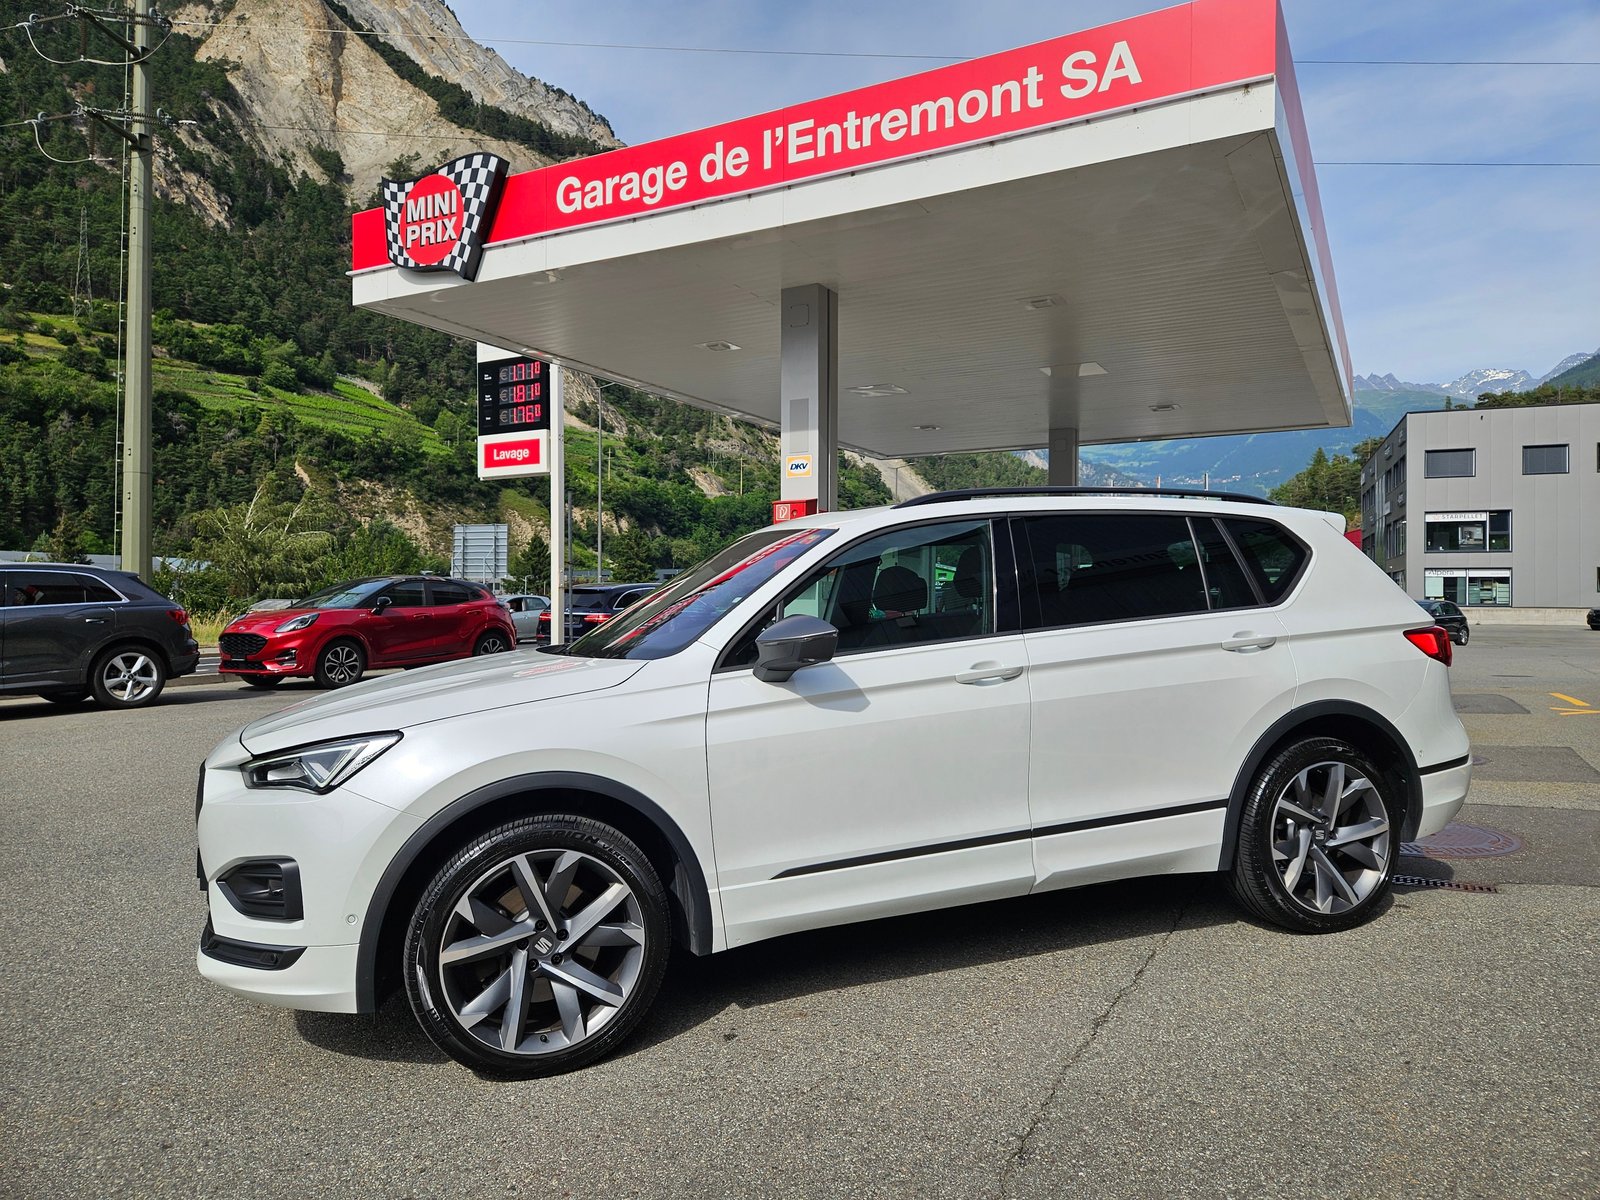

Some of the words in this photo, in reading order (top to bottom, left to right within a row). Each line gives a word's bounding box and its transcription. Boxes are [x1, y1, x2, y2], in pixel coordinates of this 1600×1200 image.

[556, 161, 688, 214] Garage
[700, 141, 749, 183] de
[763, 66, 1044, 170] l'Entremont
[1060, 40, 1142, 99] SA
[406, 189, 457, 223] MINI
[405, 216, 457, 249] PRIX
[493, 448, 530, 461] Lavage
